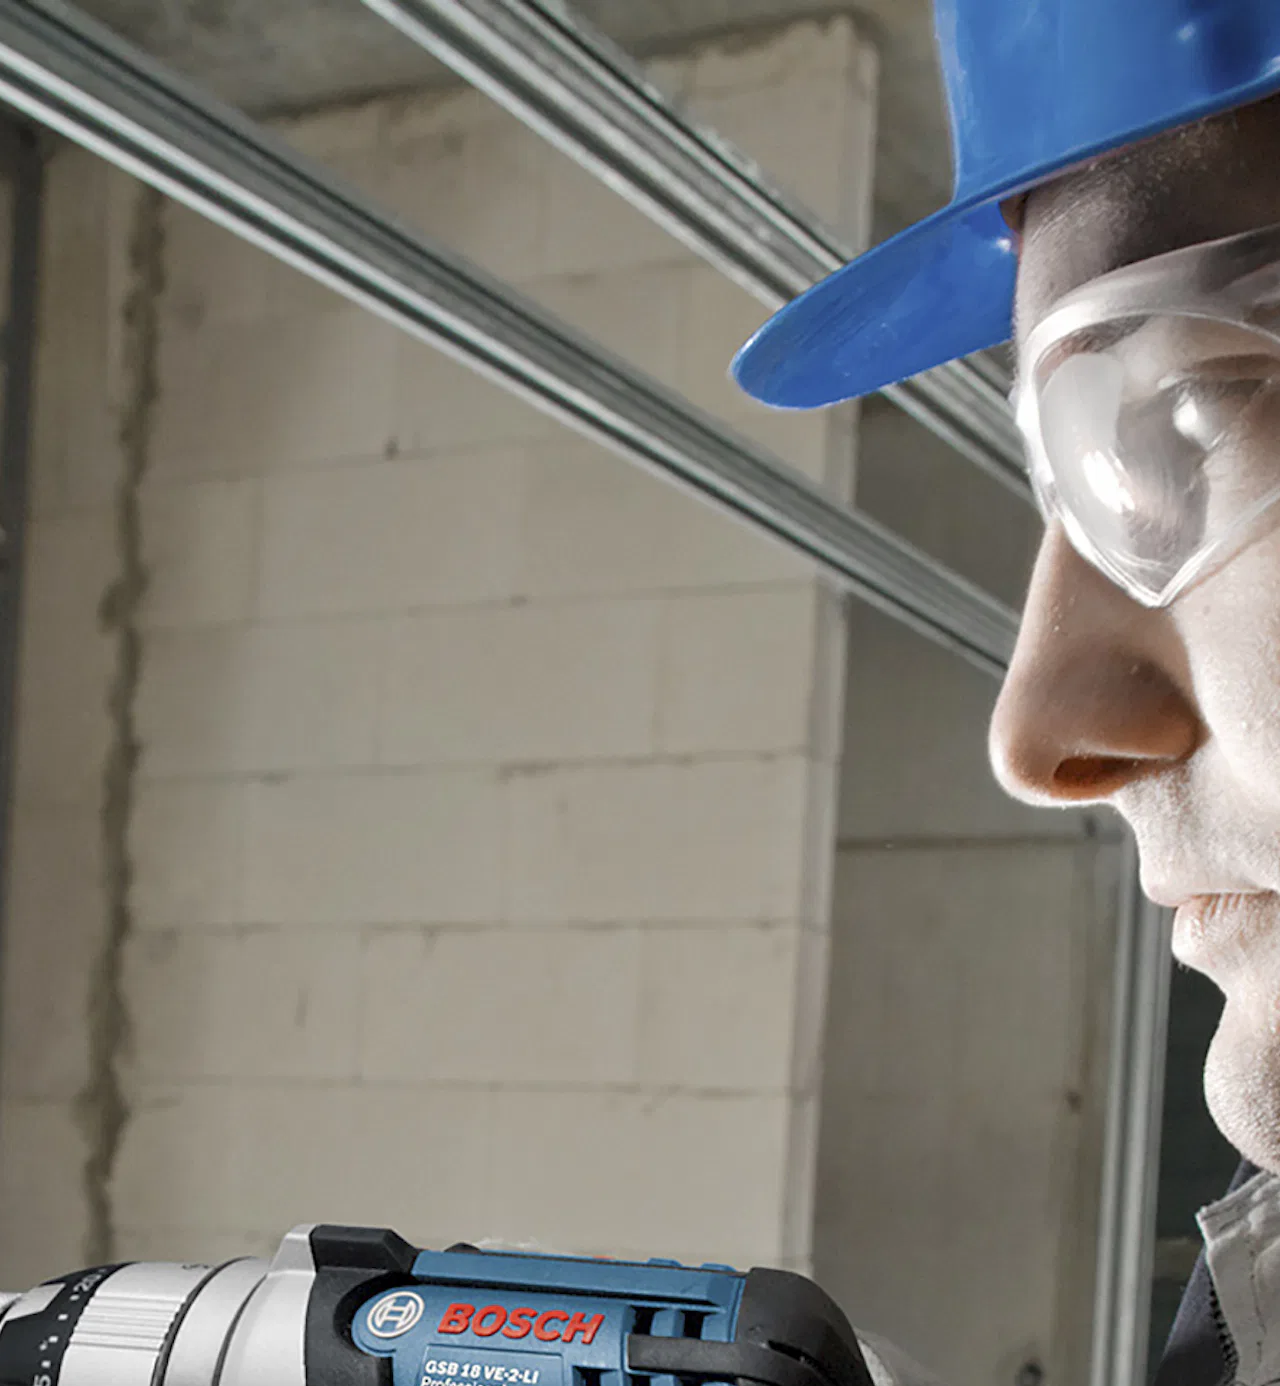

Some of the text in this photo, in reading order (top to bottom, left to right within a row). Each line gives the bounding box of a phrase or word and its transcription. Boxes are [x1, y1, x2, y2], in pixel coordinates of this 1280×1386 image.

[437, 1303, 605, 1345] BOSCH
[425, 1360, 459, 1377] GSB
[460, 1363, 480, 1380] 18
